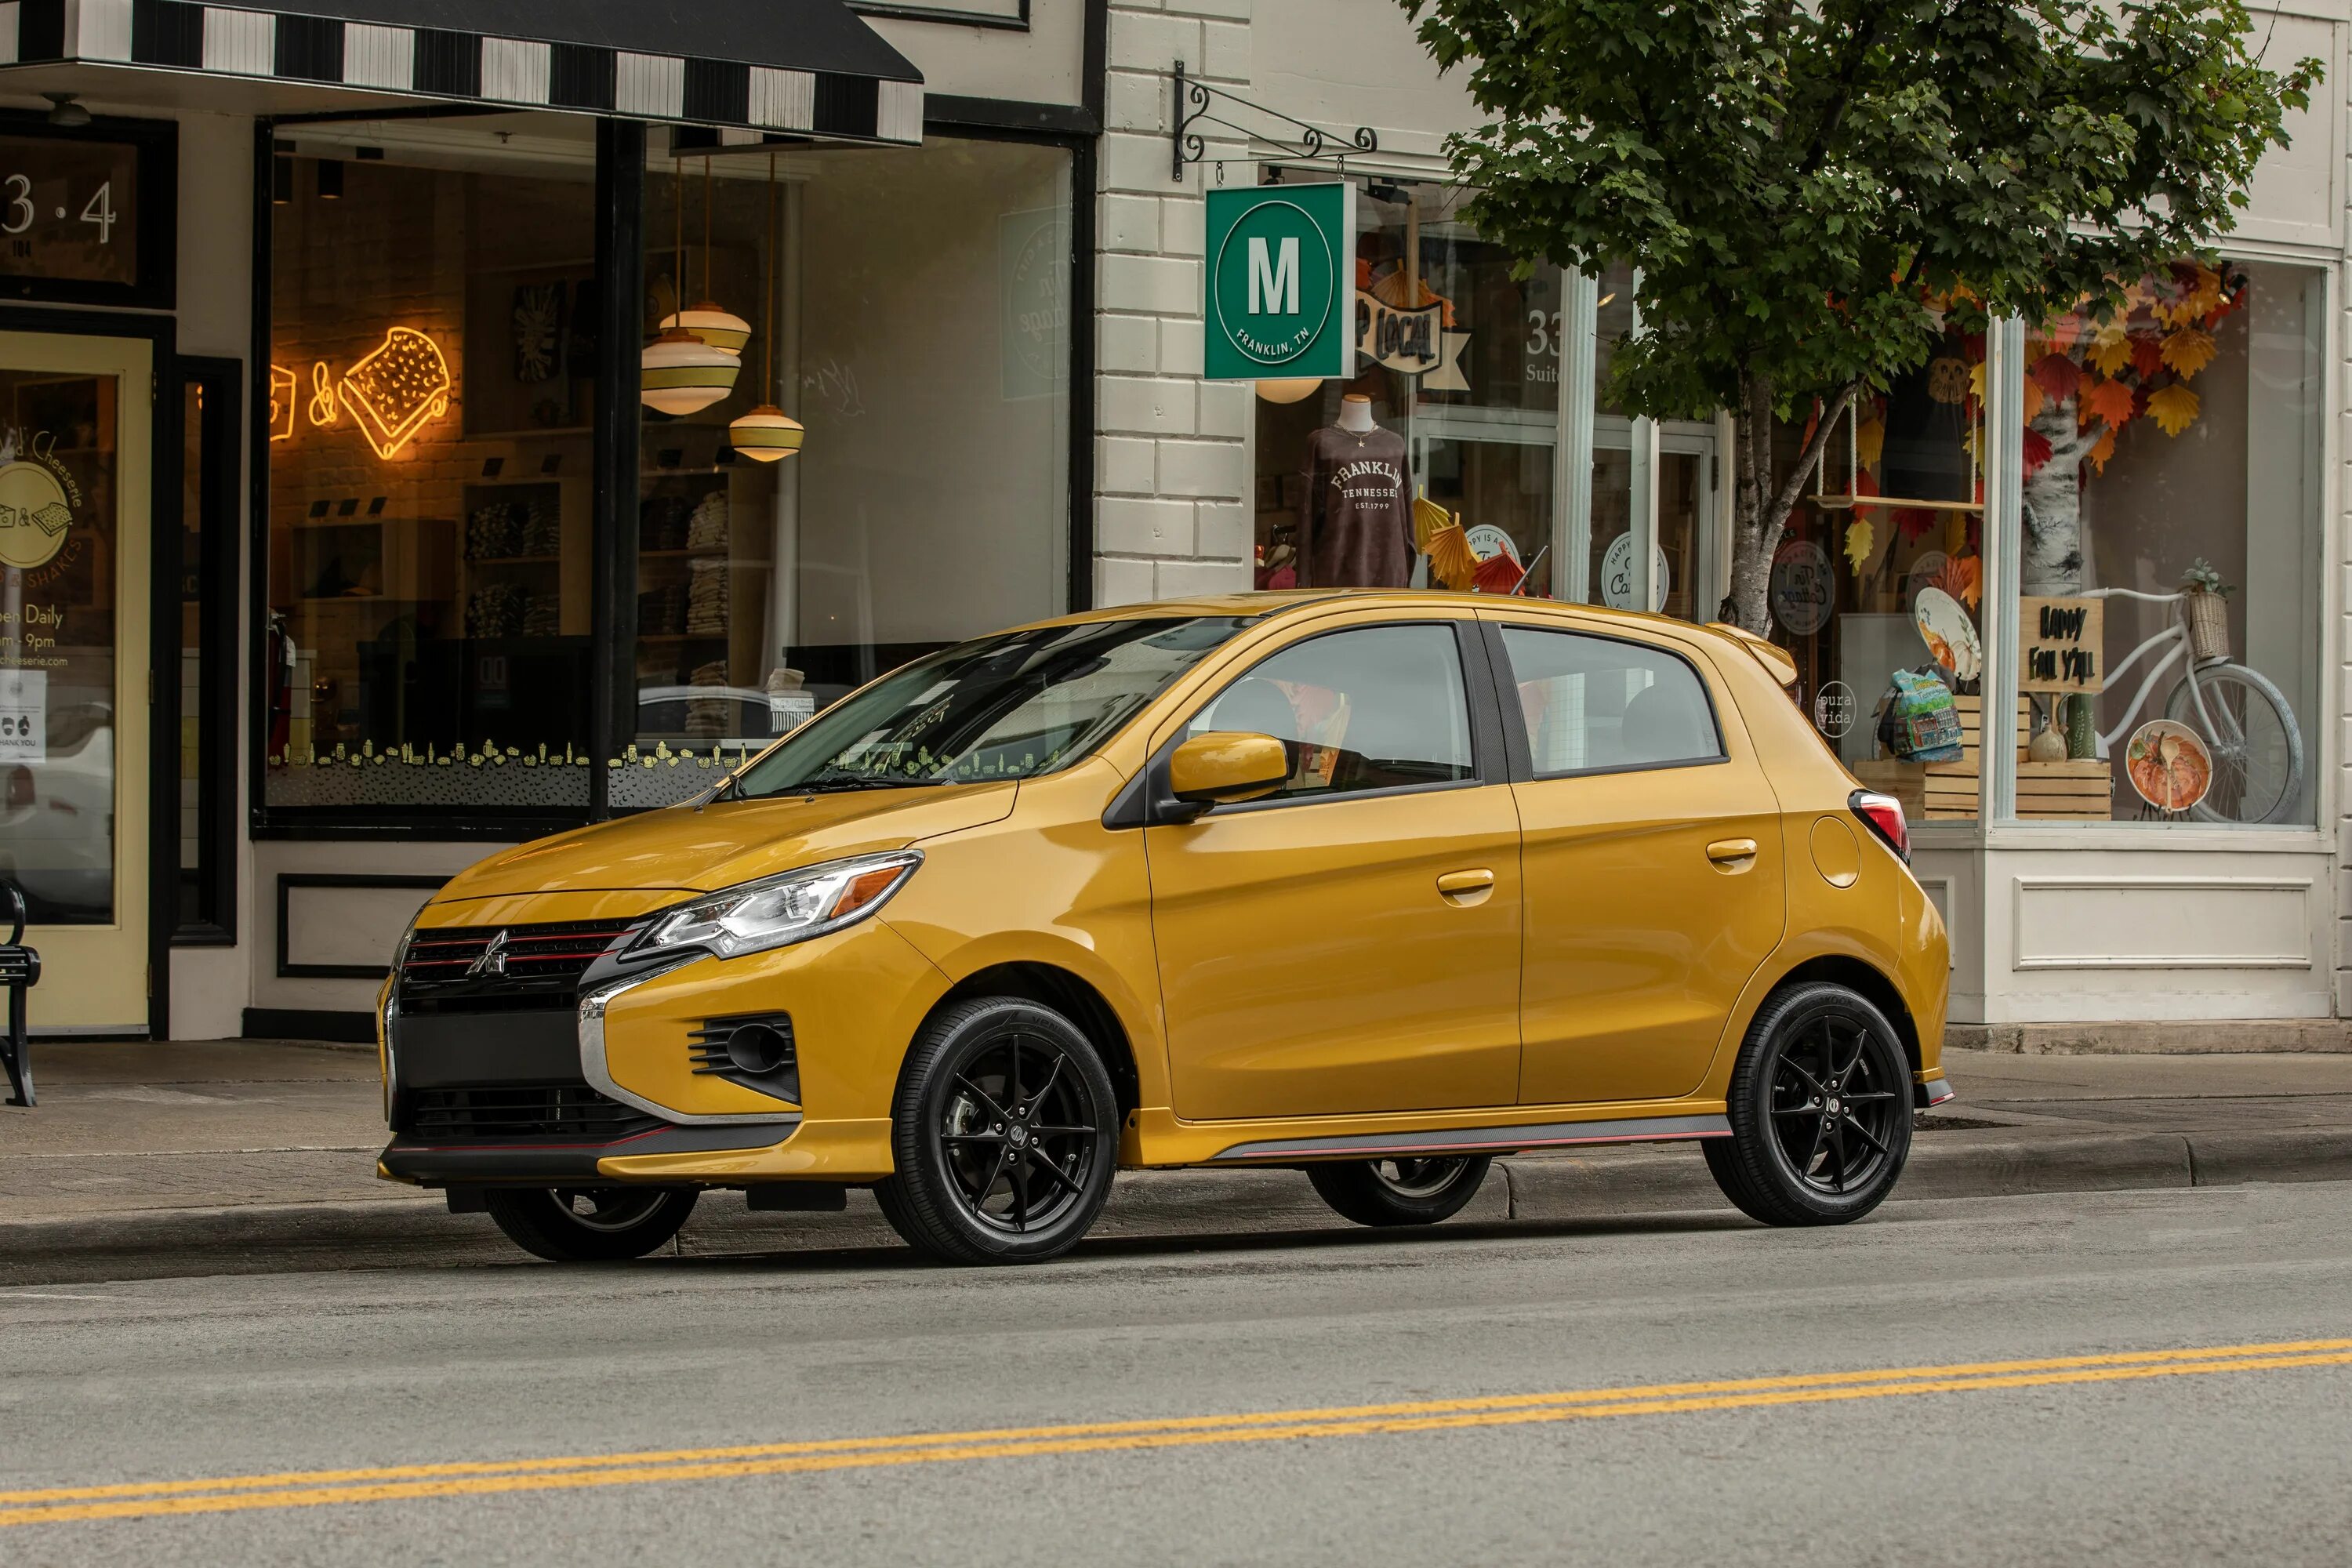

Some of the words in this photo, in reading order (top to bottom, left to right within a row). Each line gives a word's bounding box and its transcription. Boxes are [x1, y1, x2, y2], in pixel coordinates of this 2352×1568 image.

[1248, 237, 1300, 314] M
[1236, 328, 1293, 355] FRANKLIN,
[1294, 327, 1309, 345] TN
[1526, 364, 1559, 383] Suit
[32, 430, 82, 508] Cheeserie
[1330, 461, 1402, 490] FRANKLIN
[25, 604, 63, 630] Daily
[2040, 605, 2088, 642] HAPPY
[25, 633, 56, 652] 9pm
[2029, 646, 2057, 681] FALL
[1820, 695, 1852, 710] pura
[1820, 710, 1851, 724] vida
